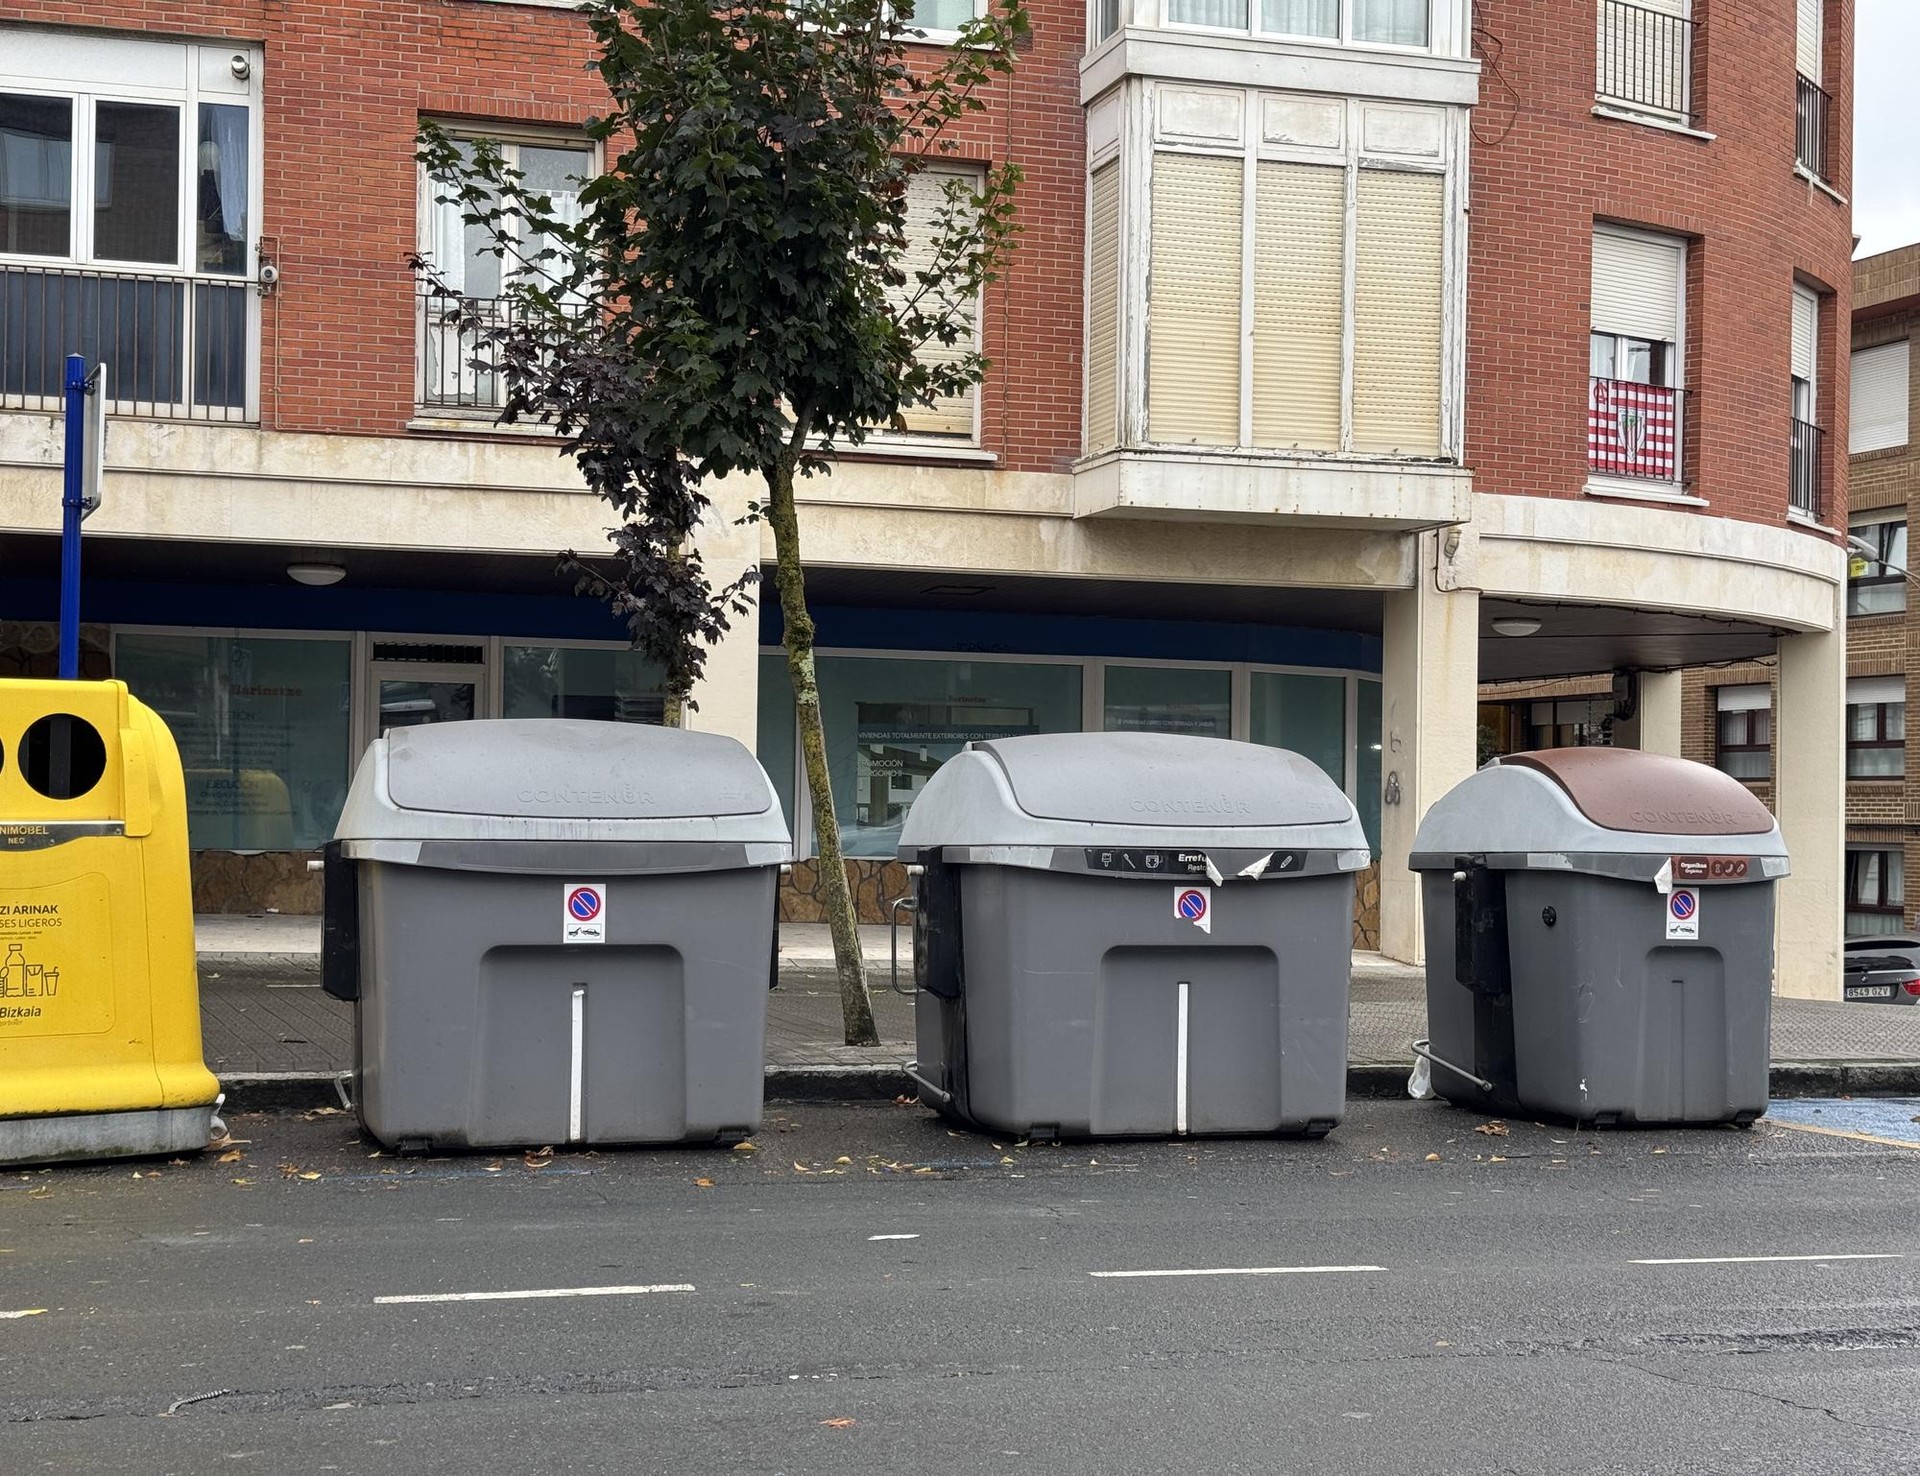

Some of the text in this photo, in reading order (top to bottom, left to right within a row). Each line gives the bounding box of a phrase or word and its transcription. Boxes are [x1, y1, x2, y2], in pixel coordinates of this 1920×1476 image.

[858, 731, 890, 739] VIVIENDAS
[932, 732, 968, 740] EXTERIORES
[969, 732, 982, 740] CON
[0, 825, 49, 835] NIMOBEL
[8, 837, 26, 845] NEO
[0, 904, 59, 915] ZI ARINAK
[0, 917, 62, 928] SES LIGEROS
[1848, 987, 1888, 997] 8549 GZV
[0, 1005, 41, 1018] Bizkaia
